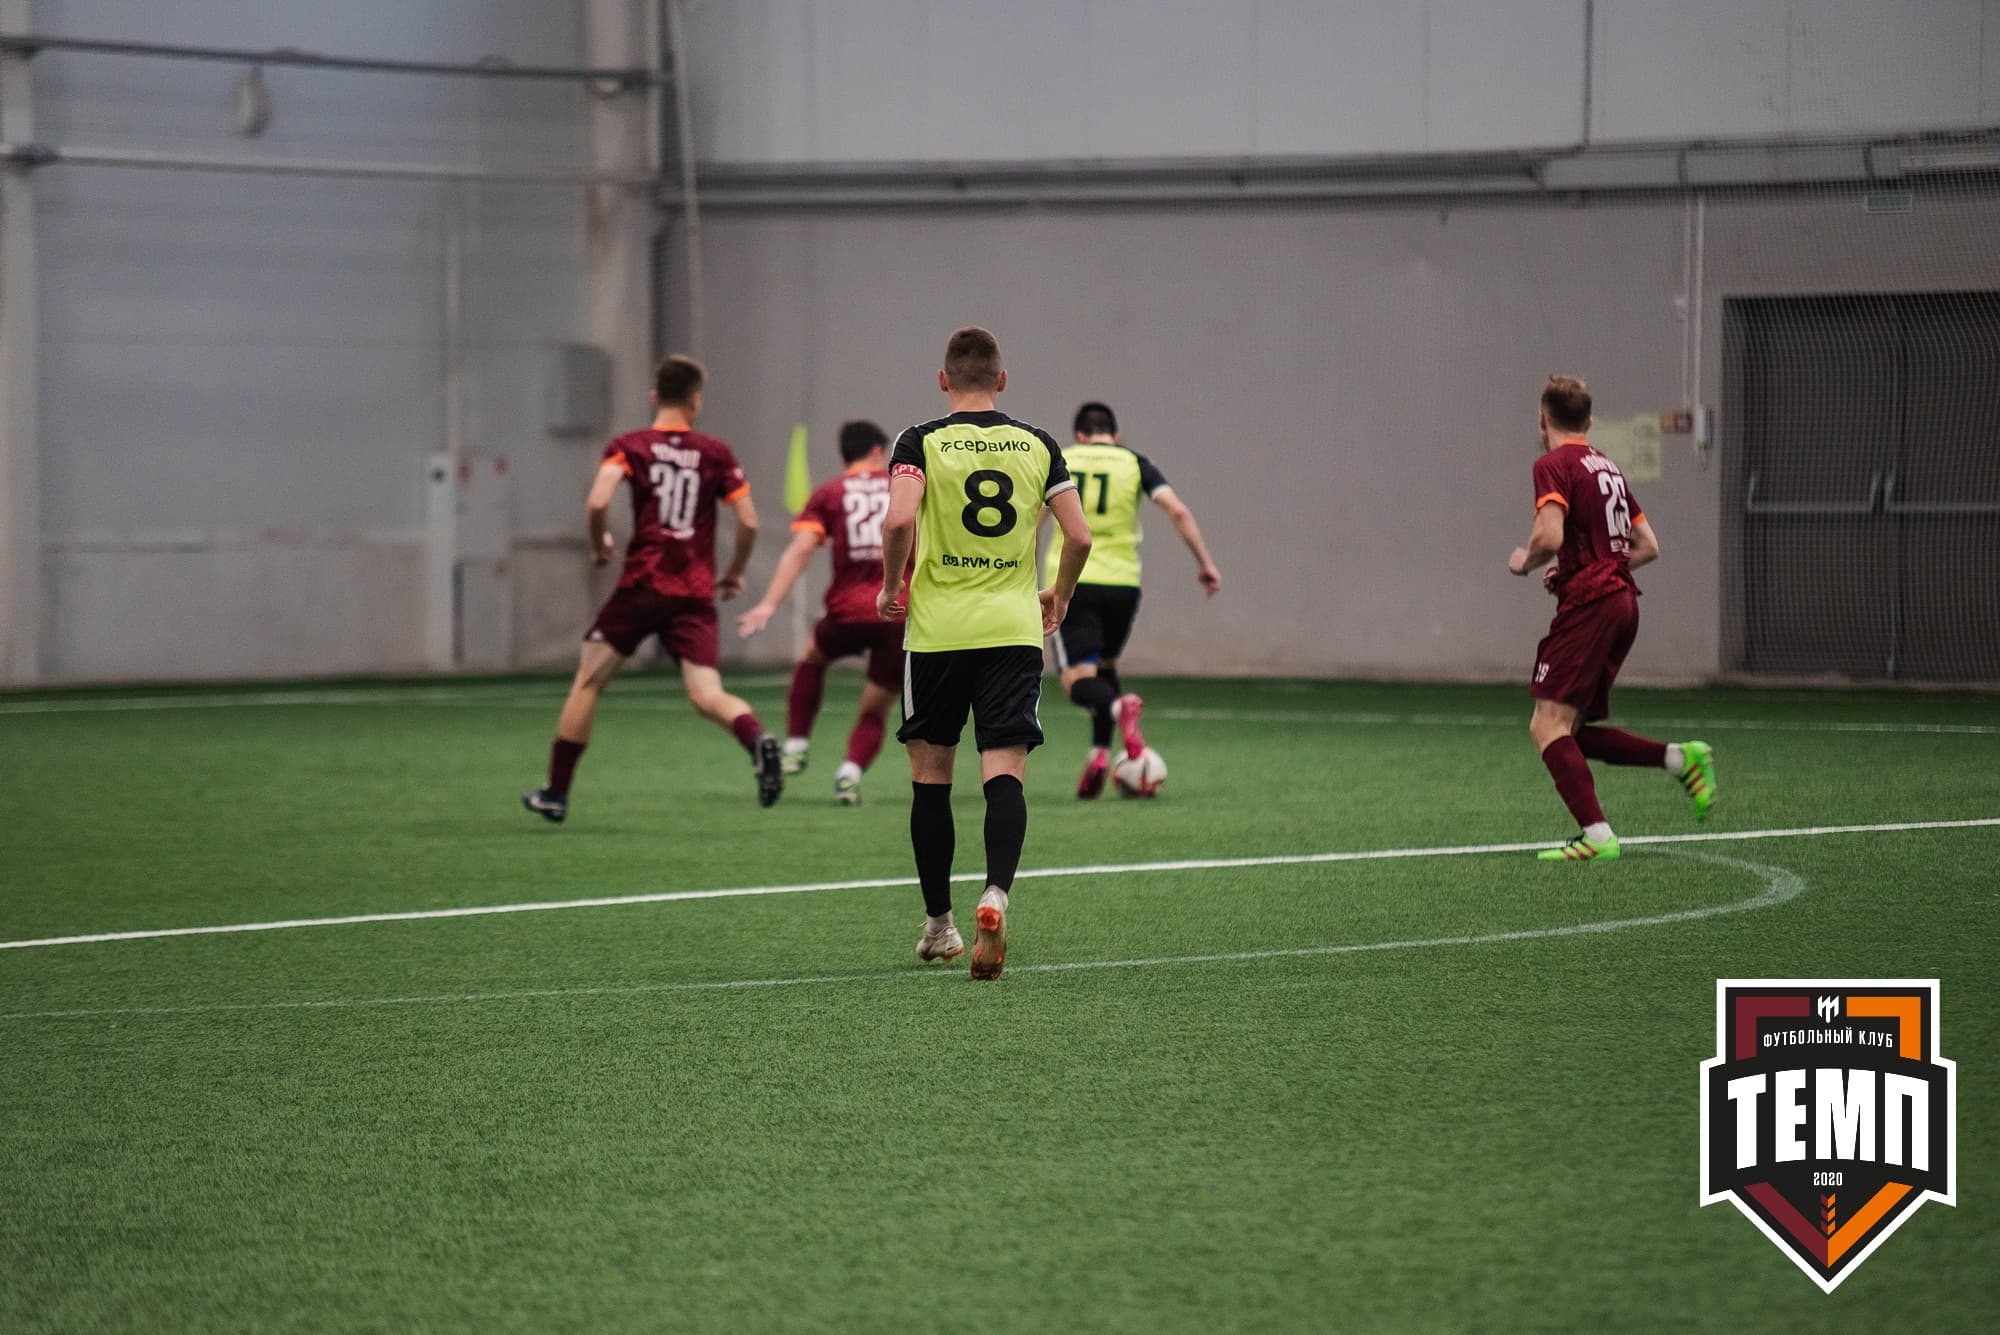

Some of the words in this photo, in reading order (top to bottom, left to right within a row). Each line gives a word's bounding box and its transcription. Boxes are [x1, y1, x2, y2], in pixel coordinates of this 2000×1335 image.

[954, 440, 1031, 454] сервико
[650, 462, 700, 530] 30
[961, 469, 1018, 538] 8
[1069, 471, 1109, 515] 11
[843, 491, 890, 547] 22
[961, 556, 990, 569] RVM
